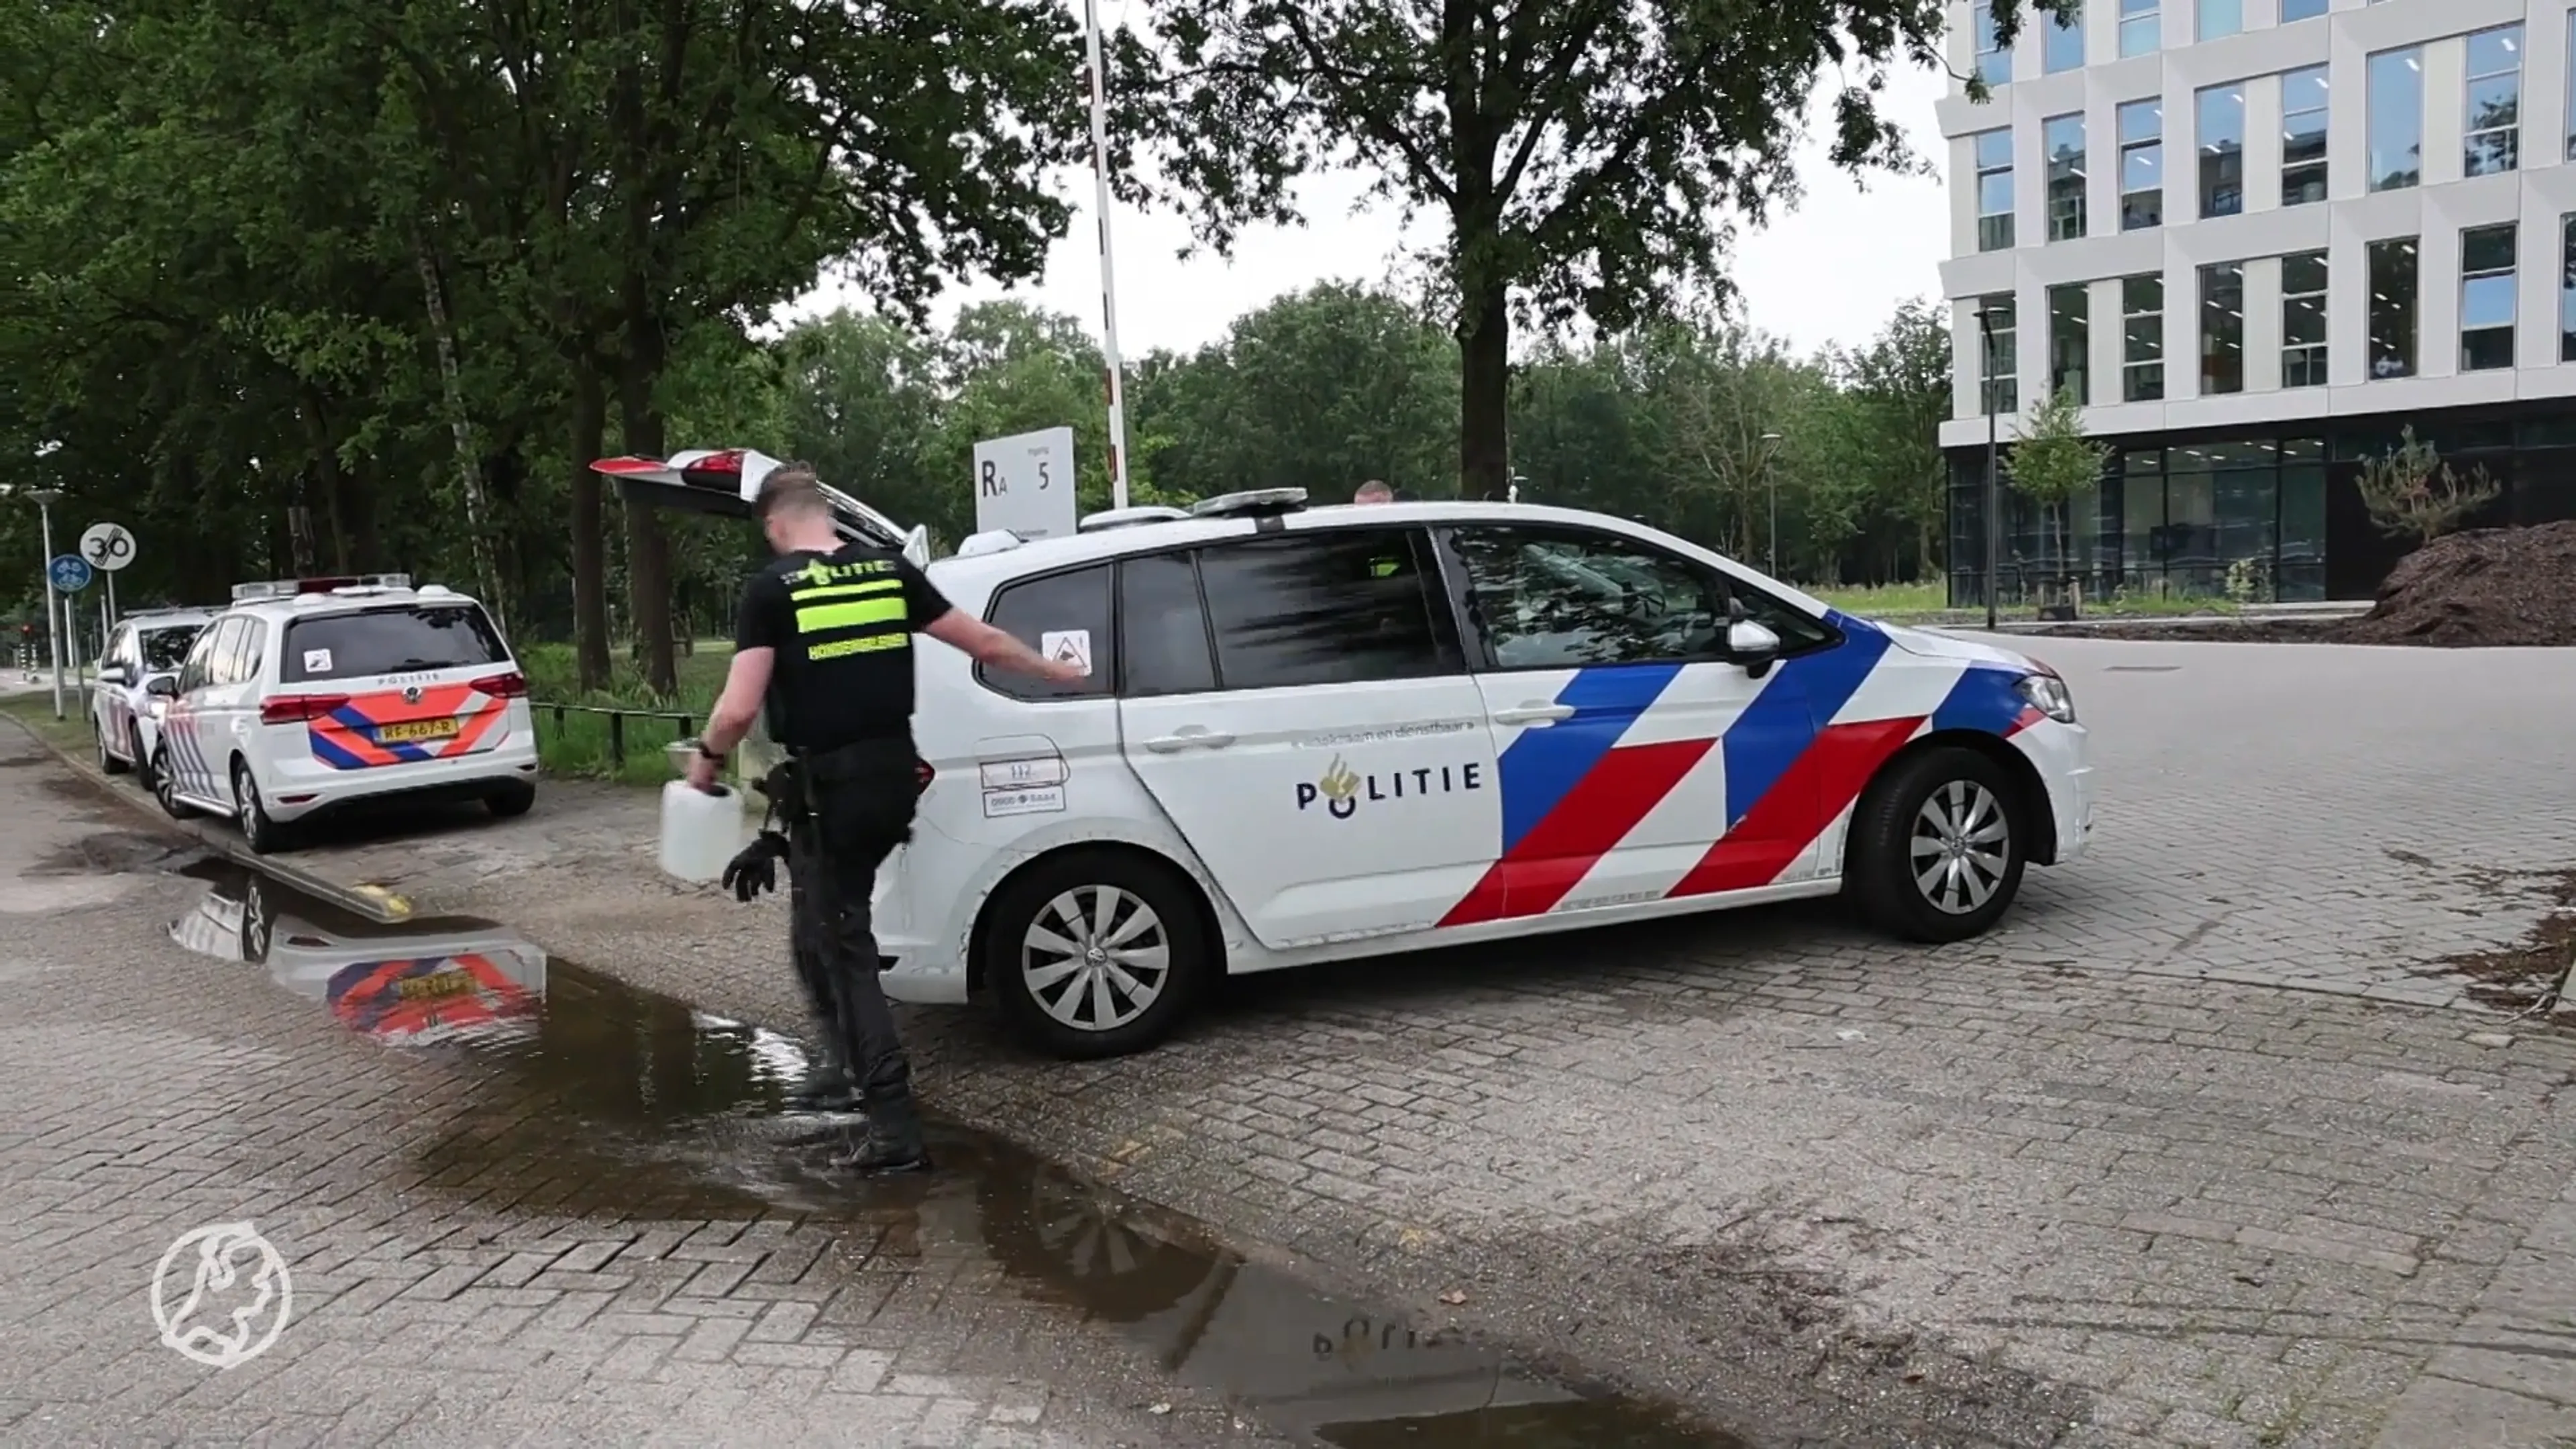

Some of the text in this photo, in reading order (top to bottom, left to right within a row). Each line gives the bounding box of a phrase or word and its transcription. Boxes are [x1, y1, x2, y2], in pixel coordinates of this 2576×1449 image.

[1039, 462, 1049, 490] 5
[89, 537, 129, 558] 30
[1296, 762, 1481, 820] POLITIE
